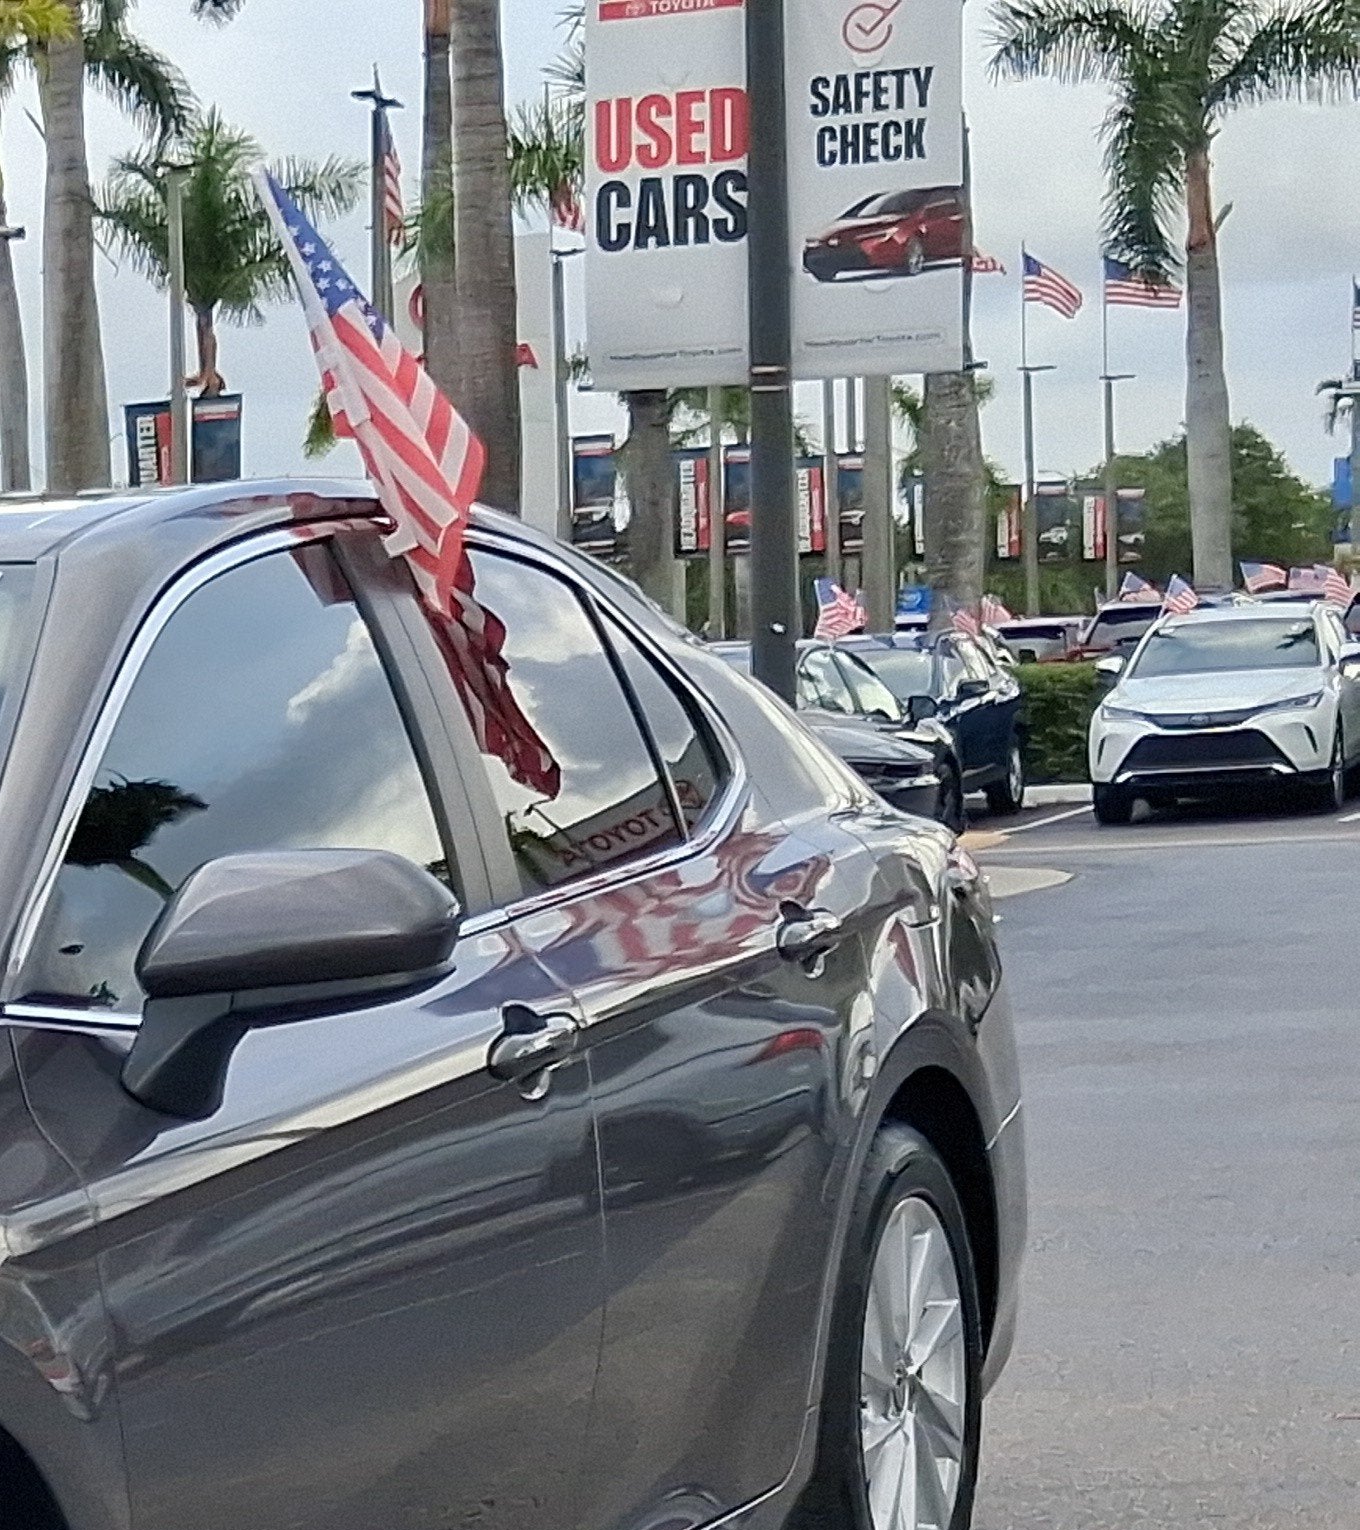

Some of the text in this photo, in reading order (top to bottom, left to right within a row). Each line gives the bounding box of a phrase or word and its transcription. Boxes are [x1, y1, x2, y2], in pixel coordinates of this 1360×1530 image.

[809, 66, 934, 118] SAFETY
[595, 86, 750, 174] USED
[816, 118, 927, 168] CHECK
[596, 168, 749, 253] CARS
